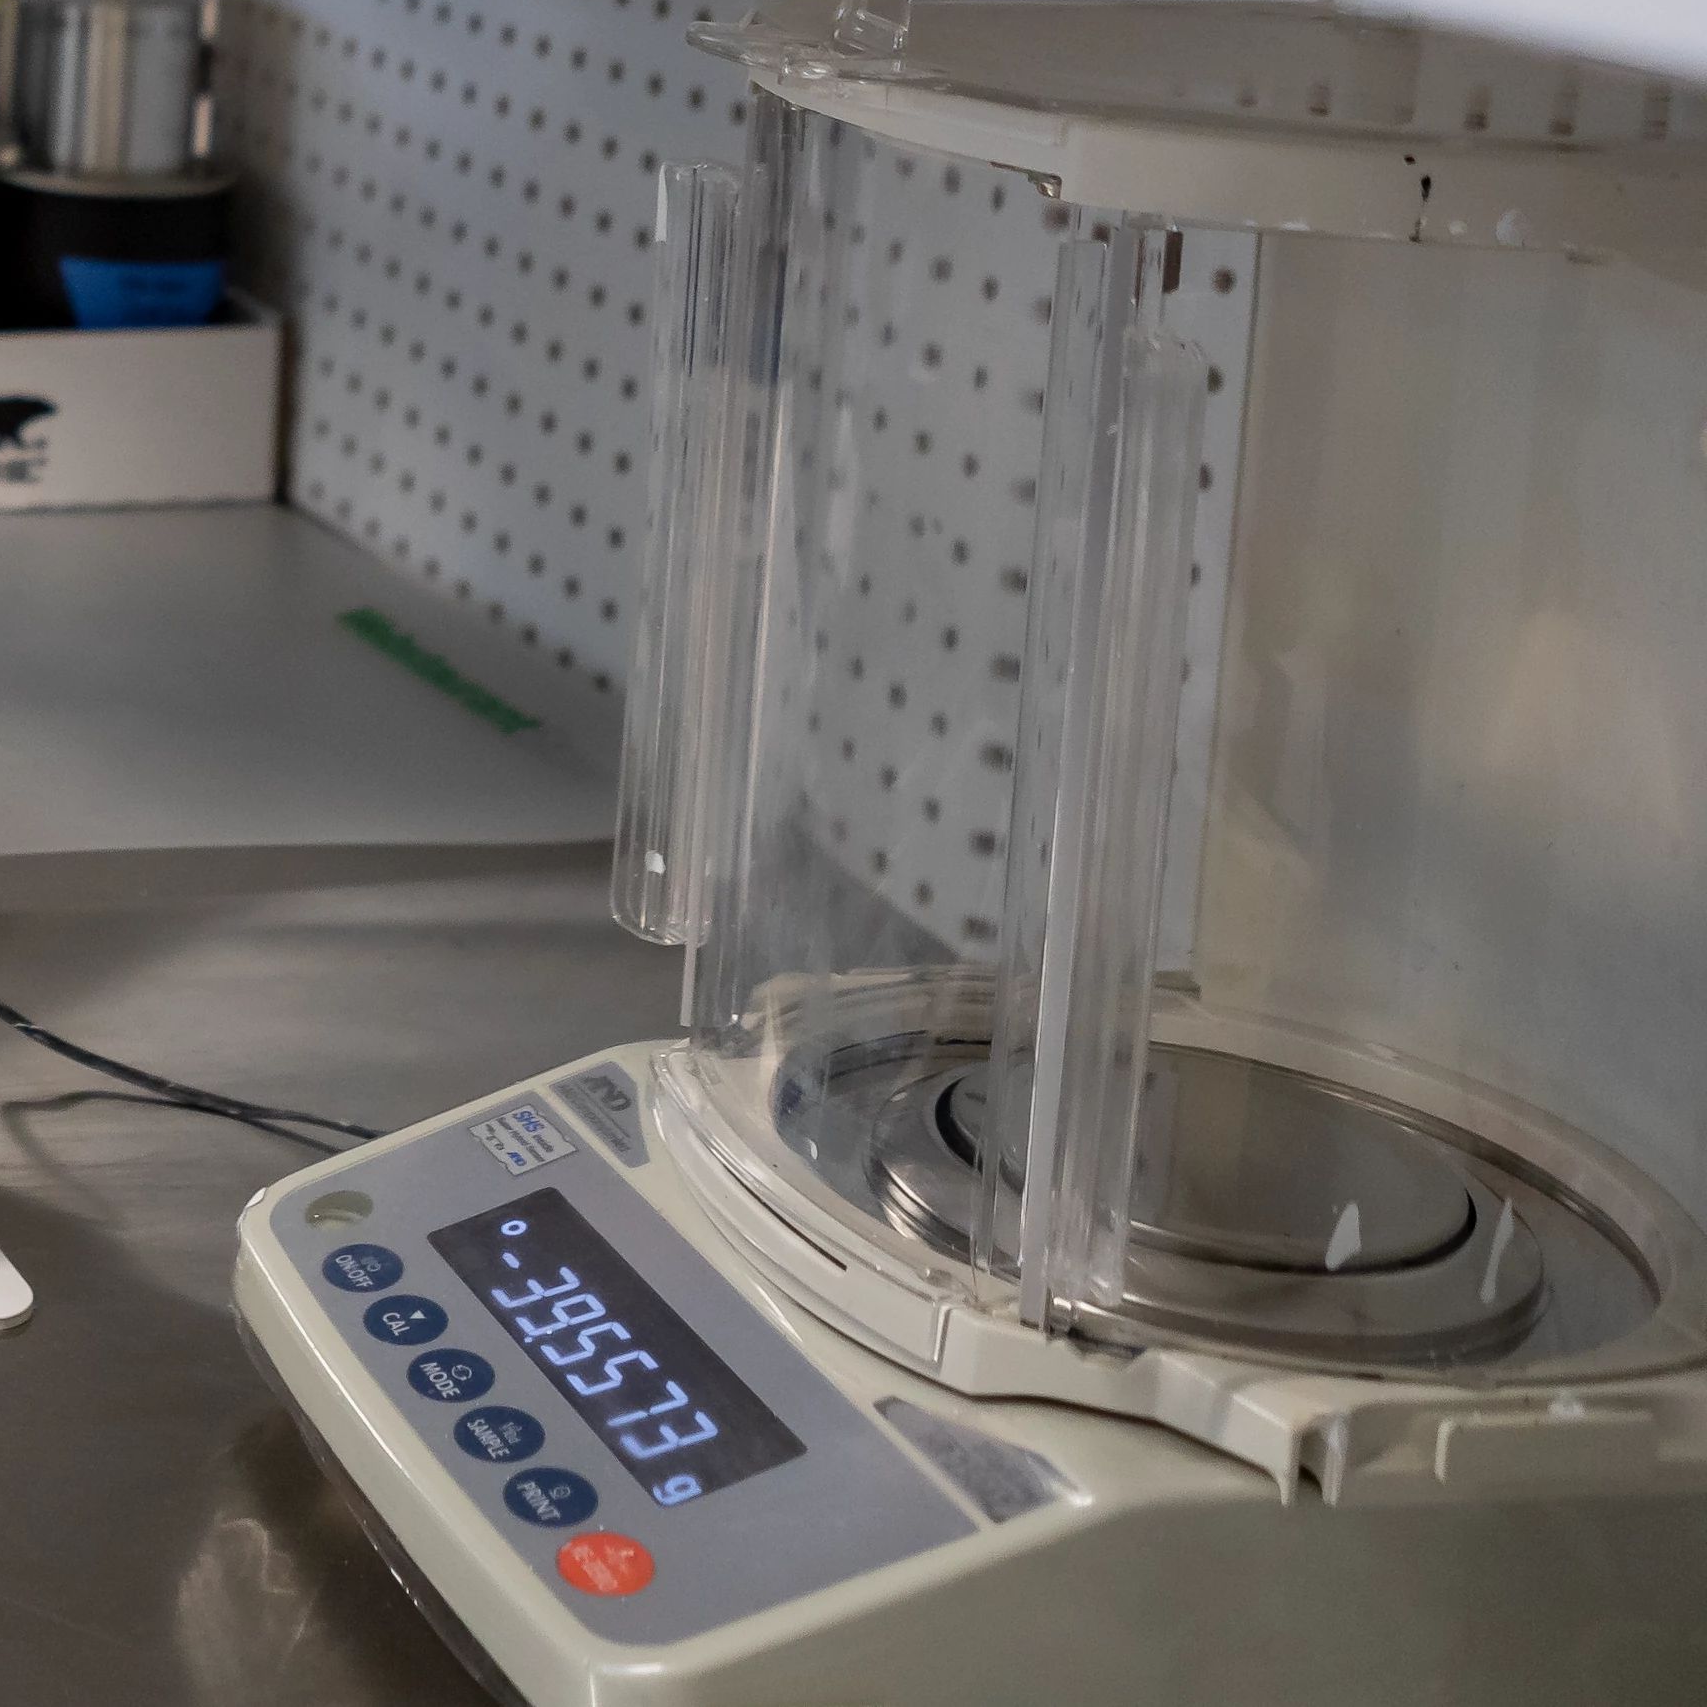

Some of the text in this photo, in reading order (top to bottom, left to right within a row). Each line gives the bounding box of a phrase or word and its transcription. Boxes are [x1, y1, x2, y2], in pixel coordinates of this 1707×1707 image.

[382, 1311, 411, 1337] CAL
[419, 1361, 462, 1399] MODE
[467, 1418, 511, 1460] SAMPLE
[516, 1480, 562, 1522] PRINT
